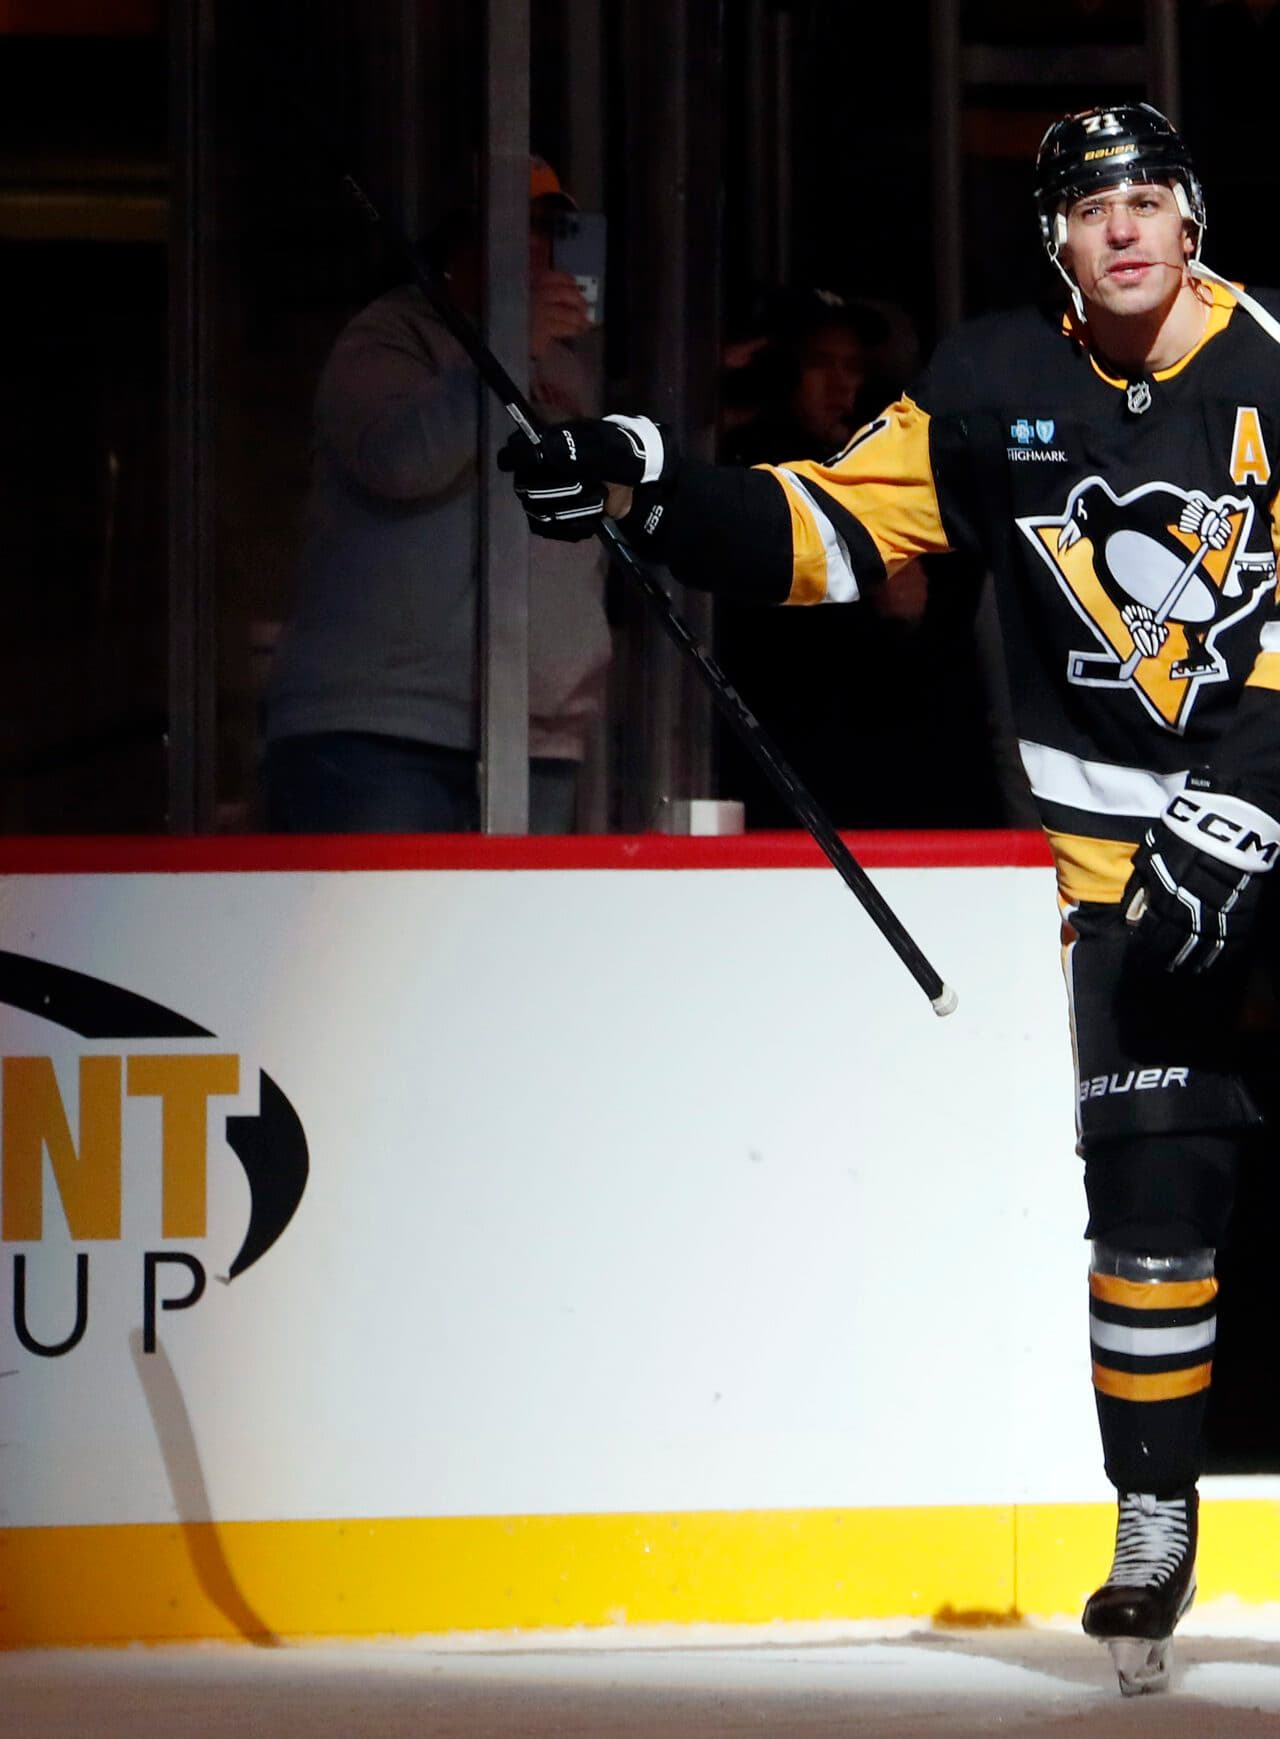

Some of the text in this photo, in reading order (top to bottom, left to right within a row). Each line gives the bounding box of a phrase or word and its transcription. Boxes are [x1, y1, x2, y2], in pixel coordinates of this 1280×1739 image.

[1082, 113, 1121, 134] 71
[1007, 449, 1066, 462] HIGHMARK
[1230, 407, 1271, 486] A
[1166, 796, 1280, 864] CCM
